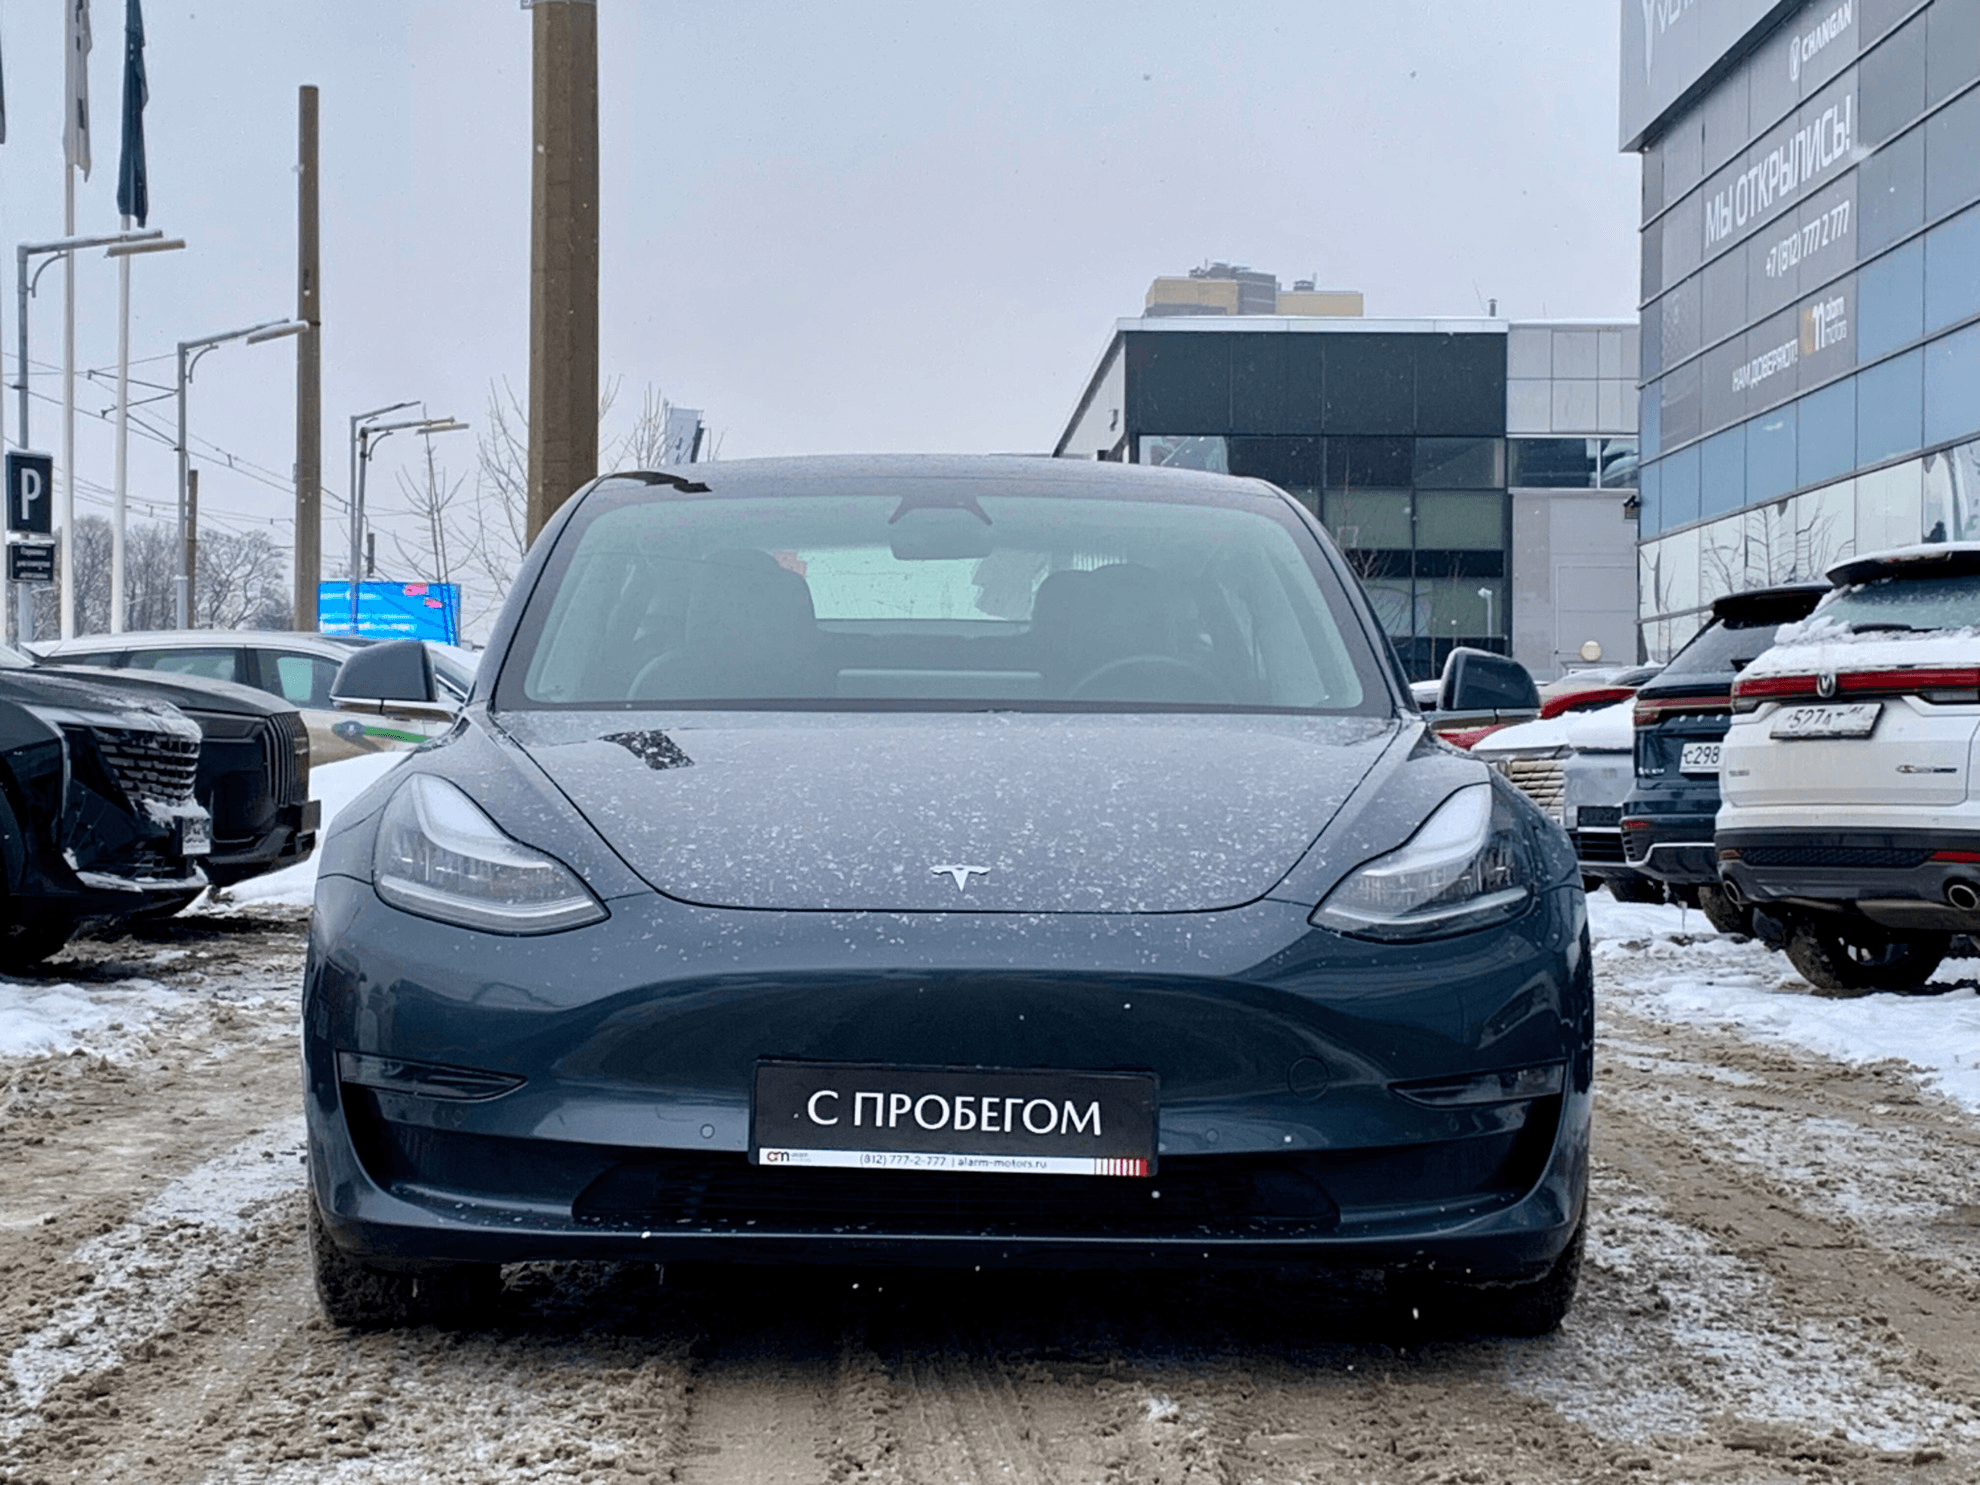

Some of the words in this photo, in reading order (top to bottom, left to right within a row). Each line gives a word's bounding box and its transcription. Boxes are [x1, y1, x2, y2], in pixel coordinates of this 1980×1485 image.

[1801, 0, 1852, 62] CHANGAN
[1705, 185, 1733, 249] МЫ
[1736, 95, 1851, 227] ОТКРЫЛИСЬ!
[1778, 231, 1801, 277] (812)
[1803, 218, 1821, 257] 777
[1821, 213, 1829, 247] 2
[1830, 200, 1850, 241] 777
[21, 467, 41, 520] P
[807, 1090, 839, 1126] С
[853, 1091, 1101, 1136] ПРОБЕГОМ
[860, 1153, 887, 1167] (812)
[889, 1154, 946, 1168] 777-2-777
[958, 1157, 1047, 1170] alarm-motors.ru
